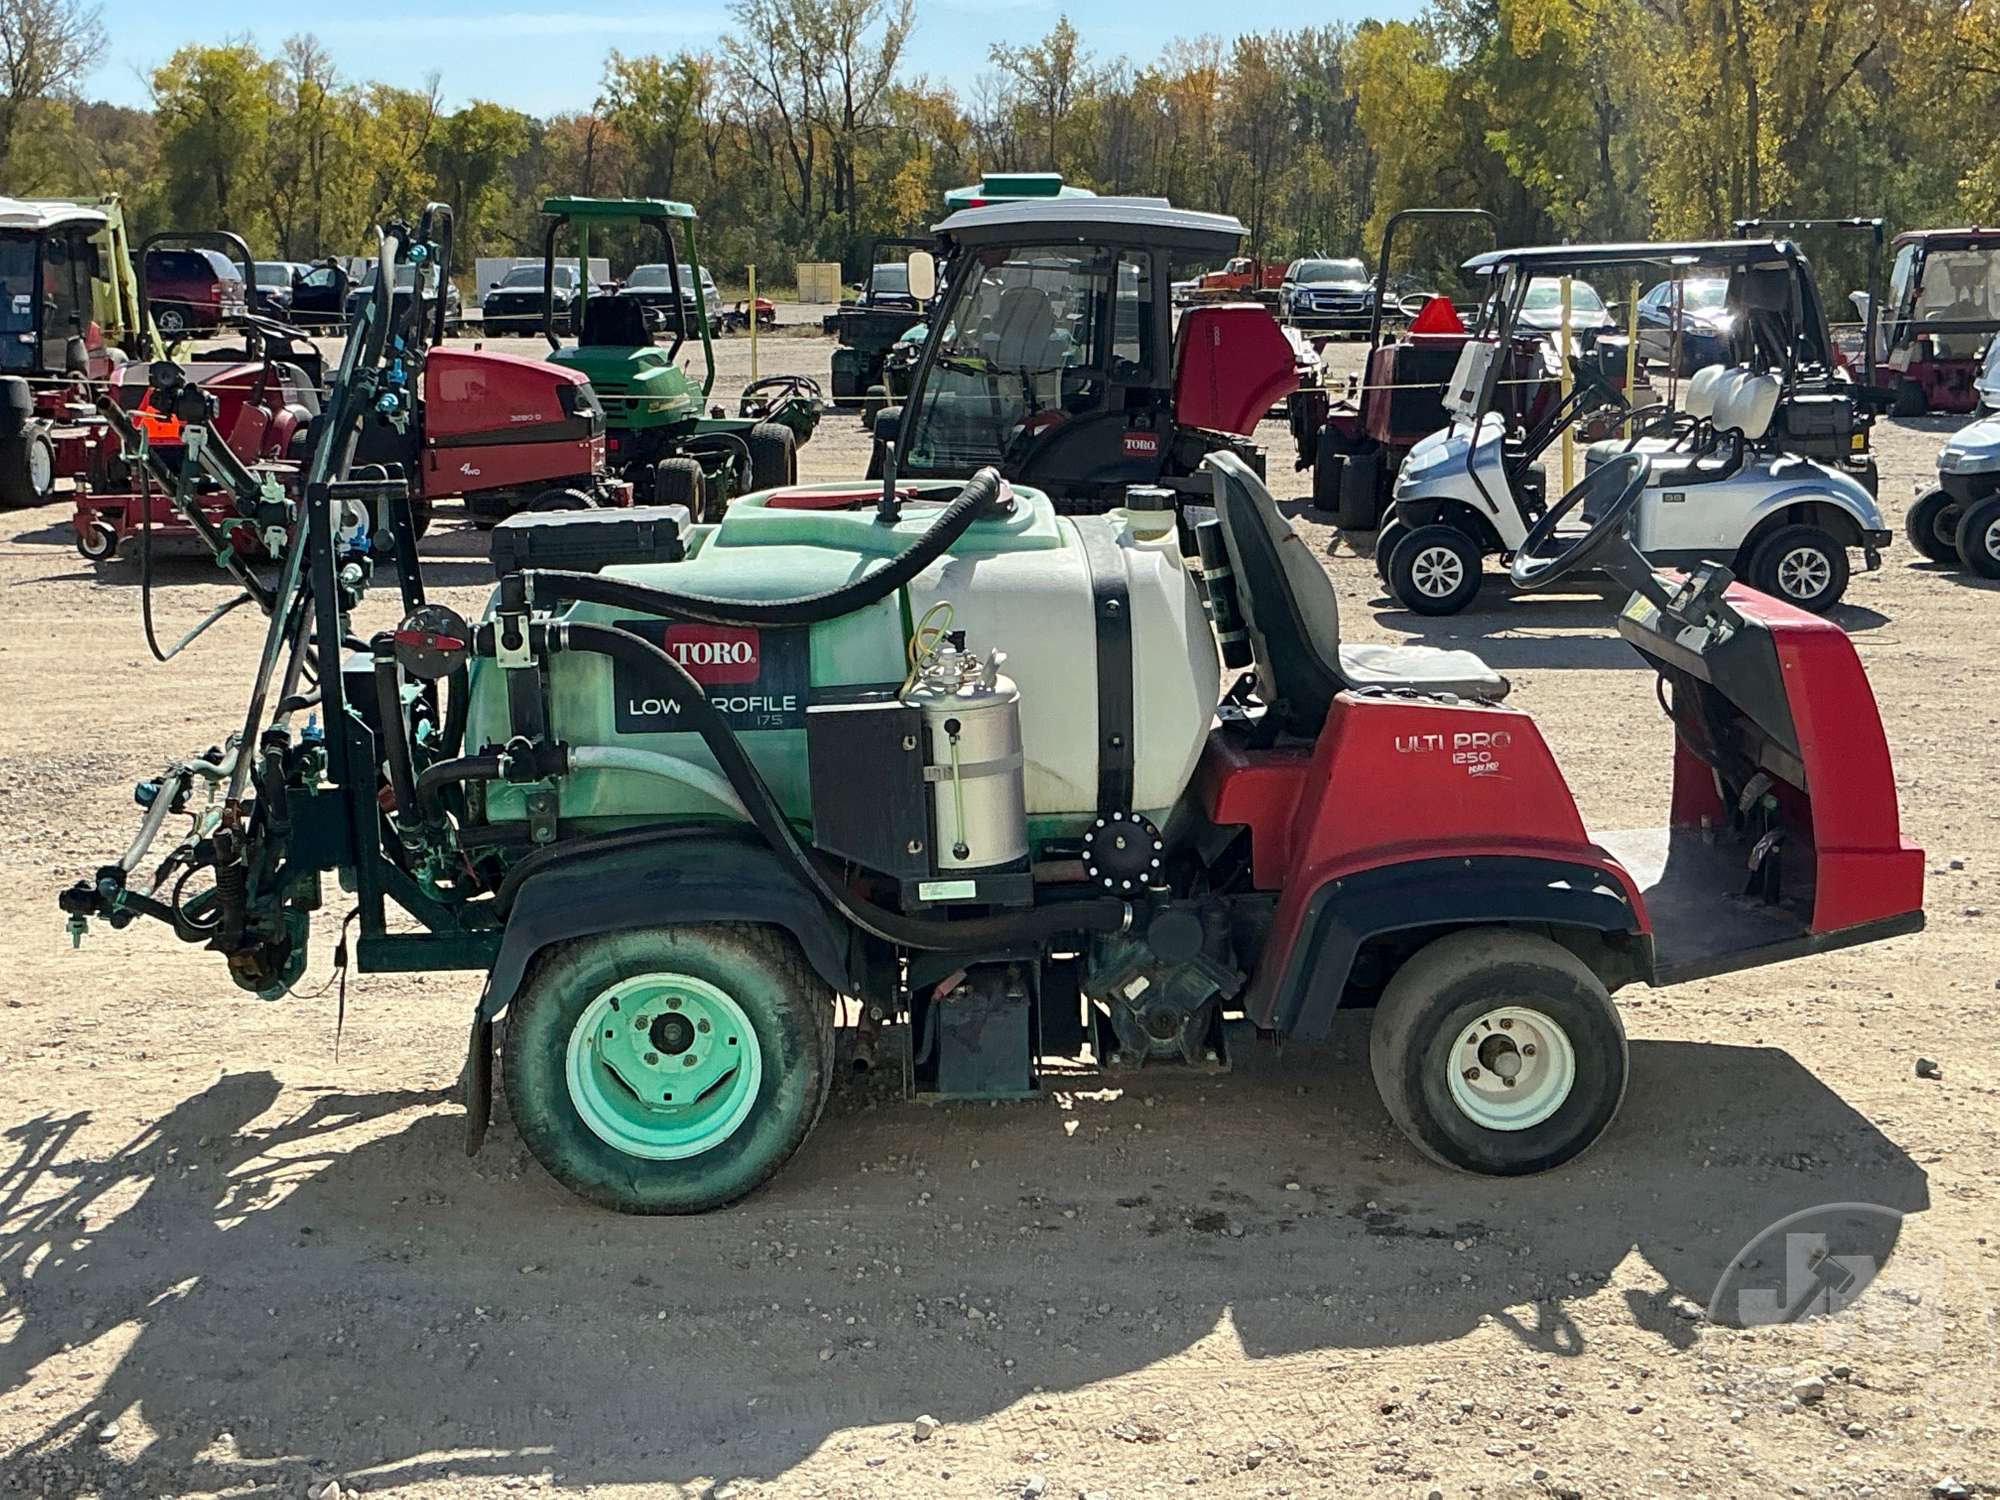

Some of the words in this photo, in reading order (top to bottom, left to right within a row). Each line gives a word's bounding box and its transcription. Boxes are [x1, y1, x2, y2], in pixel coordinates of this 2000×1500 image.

[1124, 439, 1156, 450] TORO
[672, 641, 753, 665] TORO
[629, 698, 681, 716] LOW
[711, 695, 797, 713] ROFILE
[756, 714, 784, 726] 175
[1453, 731, 1512, 750] PRO
[1452, 751, 1492, 765] 1250
